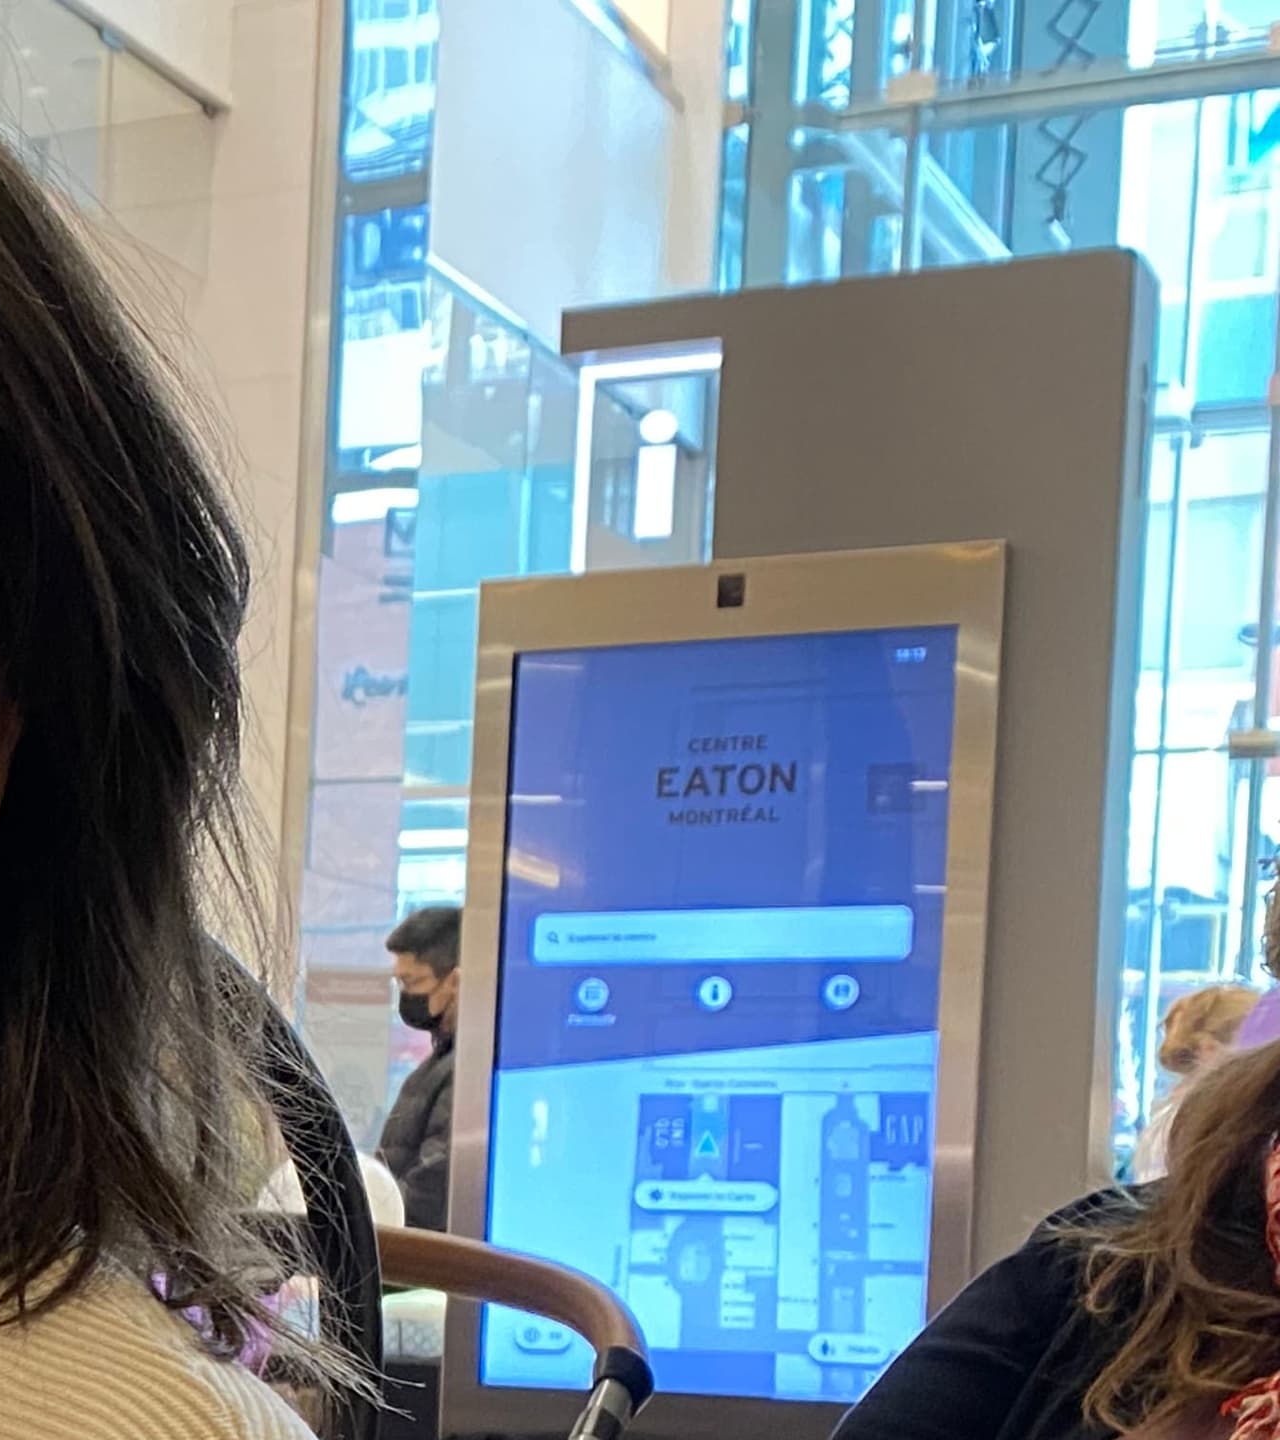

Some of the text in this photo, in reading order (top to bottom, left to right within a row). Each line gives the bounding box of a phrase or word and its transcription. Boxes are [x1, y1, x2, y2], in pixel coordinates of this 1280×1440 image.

[688, 734, 768, 752] CENTRE
[656, 760, 797, 798] EATON
[669, 803, 780, 825] MONTRÉAL
[886, 1114, 924, 1145] GAP
